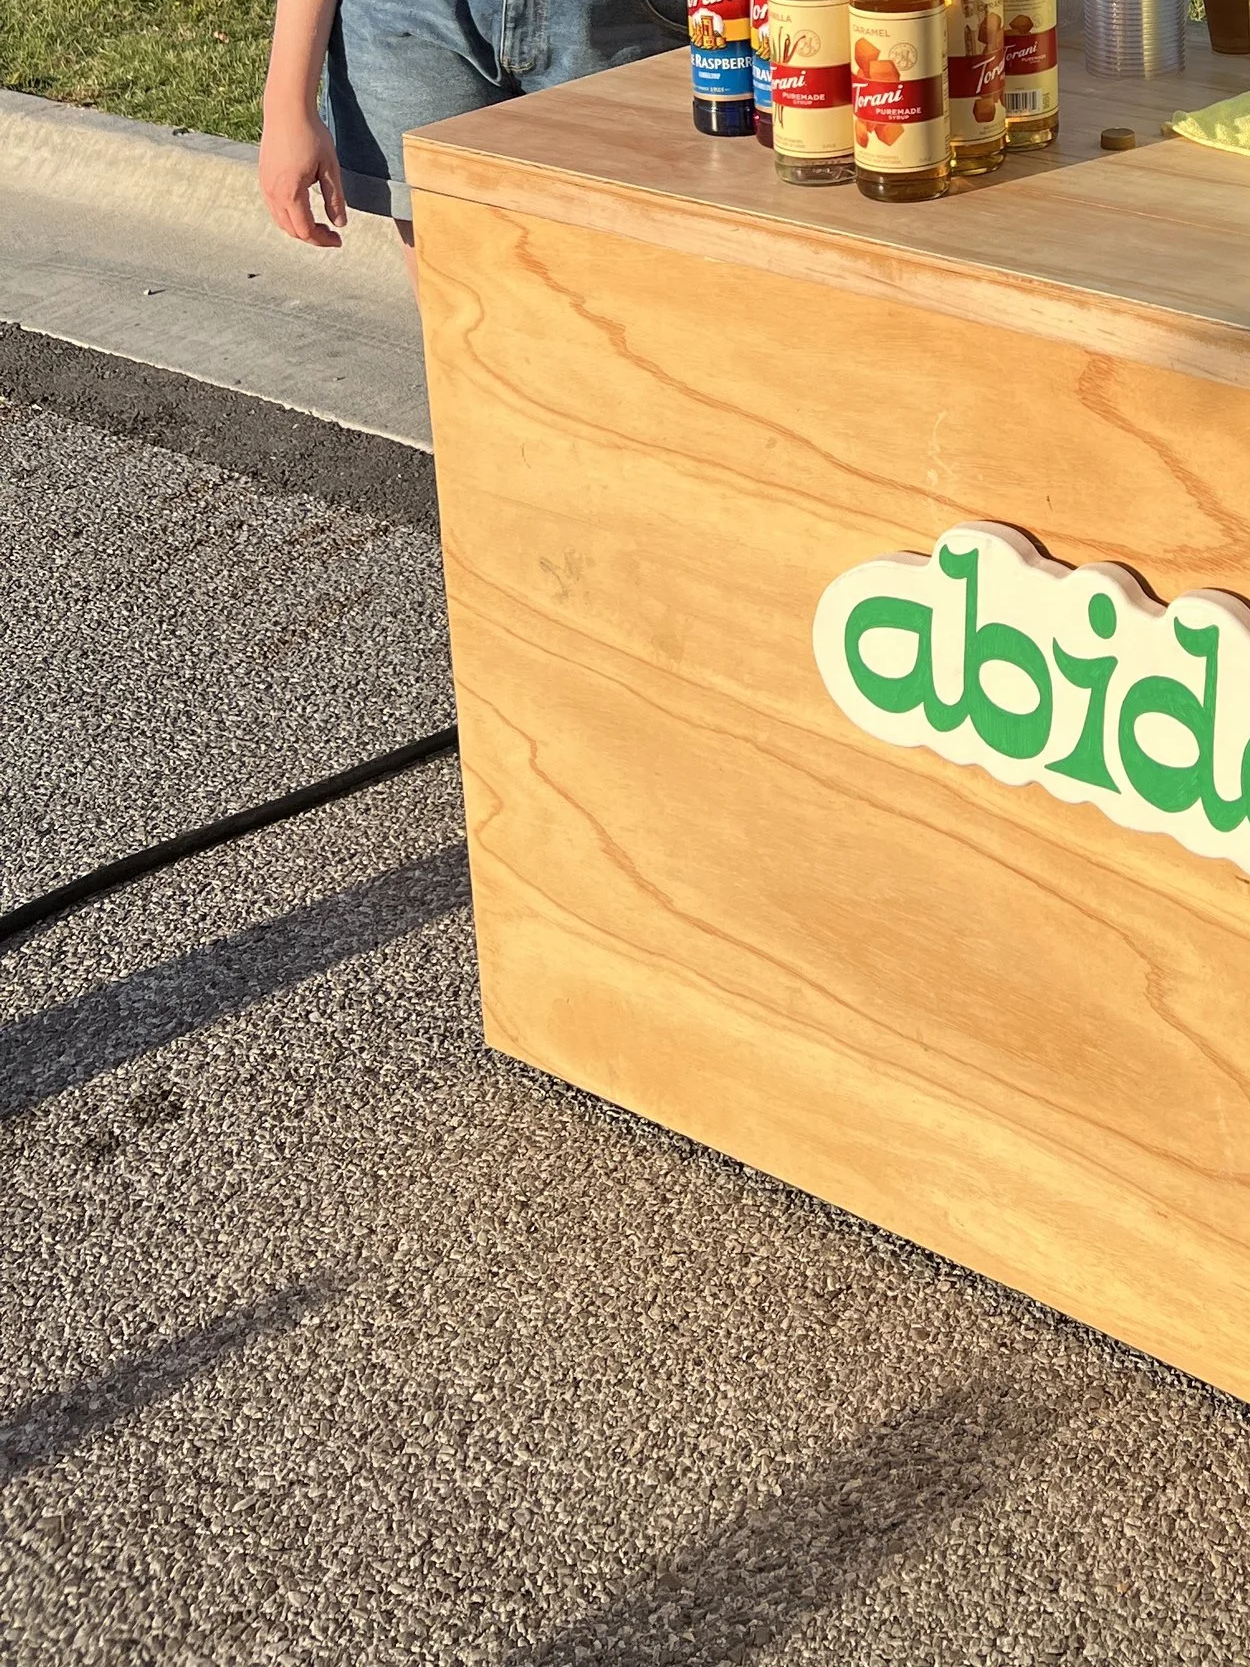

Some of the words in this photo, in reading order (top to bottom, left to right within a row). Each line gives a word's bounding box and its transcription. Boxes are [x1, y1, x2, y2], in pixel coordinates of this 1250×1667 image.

[695, 53, 753, 71] RASPBERR
[972, 55, 1005, 94] Tora
[782, 91, 826, 101] PUREMADE
[852, 83, 904, 113] Torani
[875, 107, 922, 116] PUREMADE
